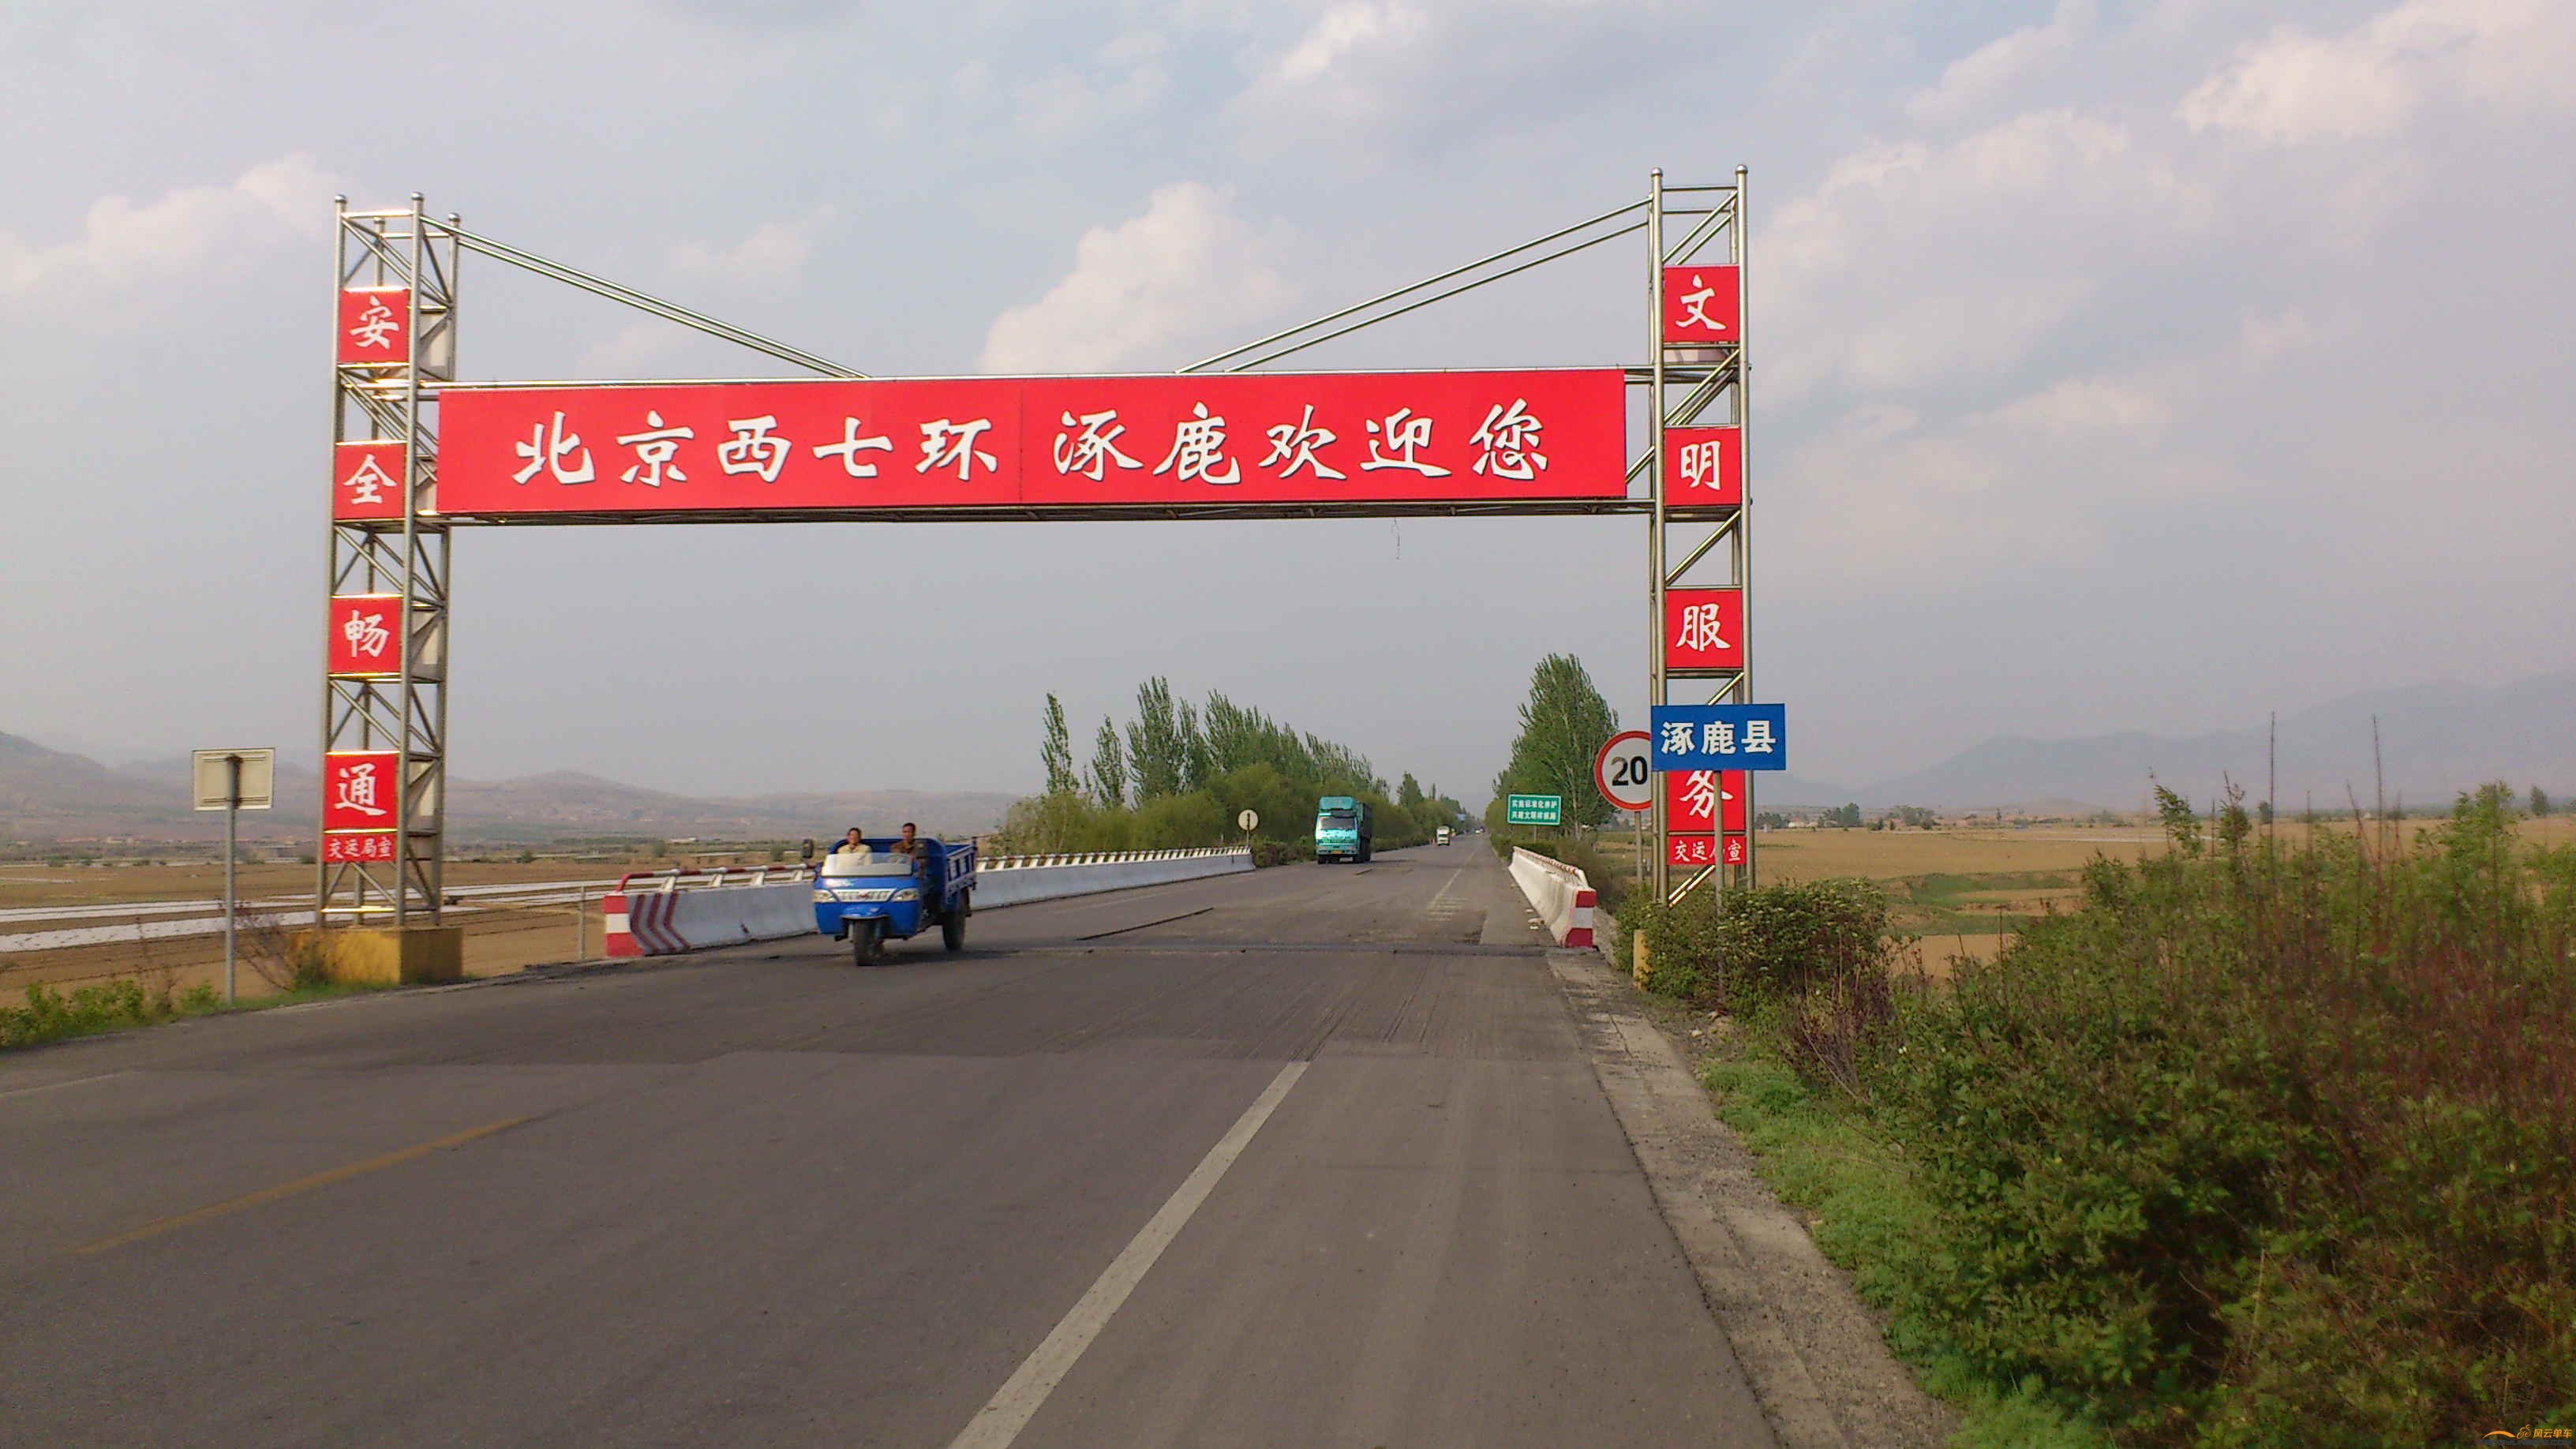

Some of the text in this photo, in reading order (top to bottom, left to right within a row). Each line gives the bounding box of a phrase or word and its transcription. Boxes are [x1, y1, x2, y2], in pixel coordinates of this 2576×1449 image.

[512, 397, 1548, 488] 北京西七环 涿鹿欢迎您
[1660, 720, 1777, 755] 涿鹿县
[1610, 755, 1649, 787] 20
[328, 837, 393, 859] 交运局宣
[1674, 839, 1743, 863] 交运宣
